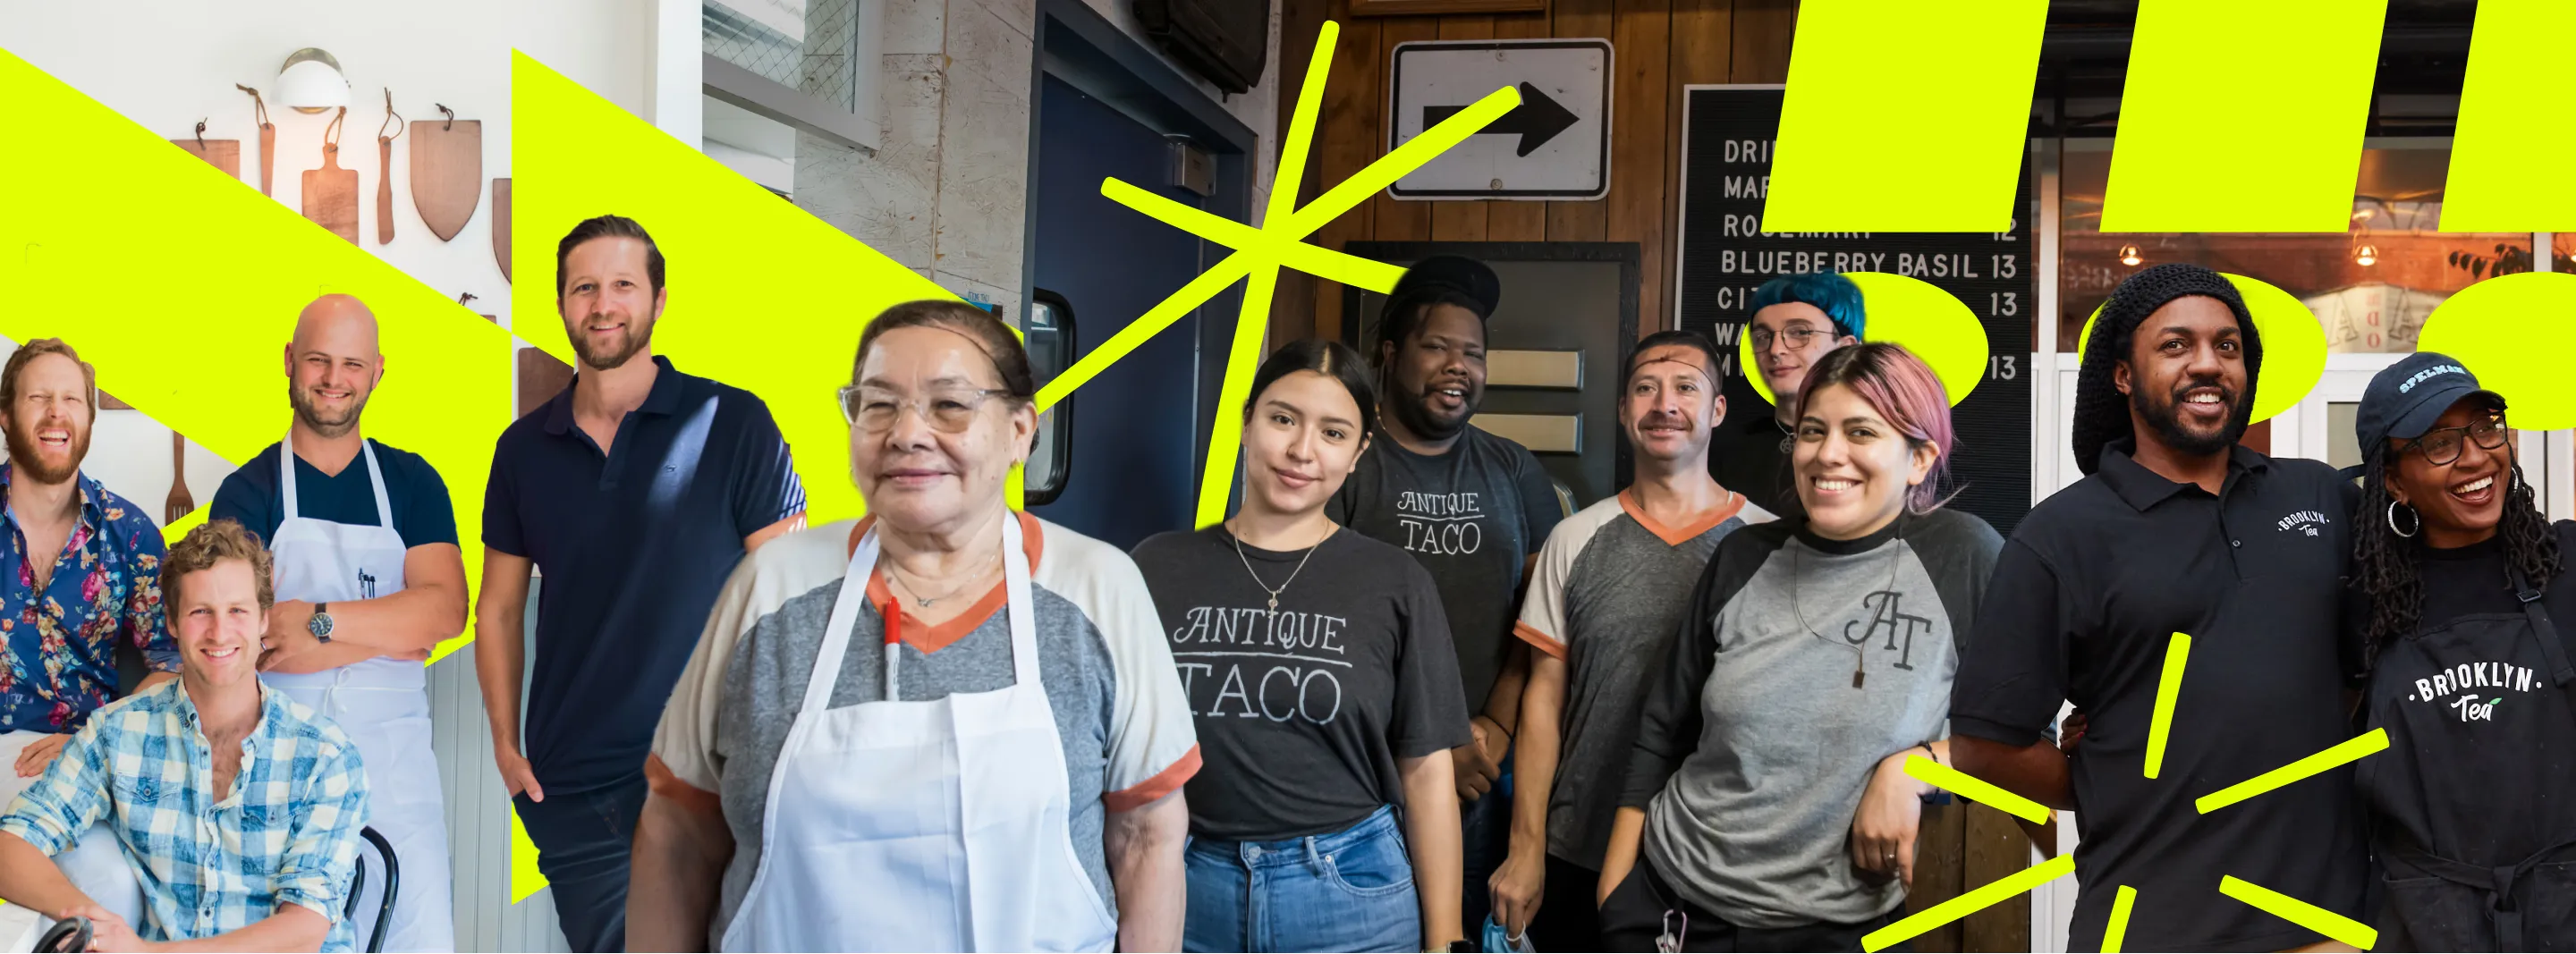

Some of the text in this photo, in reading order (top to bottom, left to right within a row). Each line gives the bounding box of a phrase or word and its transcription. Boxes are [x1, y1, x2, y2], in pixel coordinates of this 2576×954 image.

[1724, 139, 1776, 163] DRI
[1721, 250, 2017, 279] BLUEBERRY BASIL 13
[1991, 292, 2018, 317] 13
[1990, 355, 2016, 380] 13
[2399, 364, 2466, 393] SPELMAN
[1397, 491, 1479, 515] ANTIQUE
[2277, 511, 2326, 530] BROOKLYN
[2298, 524, 2318, 536] Tea
[1400, 519, 1480, 555] TACO
[1174, 606, 1346, 654] ANTIQUE
[1843, 590, 1932, 671] AT
[2414, 662, 2533, 693] BROOKLYN
[1176, 663, 1341, 725] TACO
[2450, 694, 2494, 722] Tea
